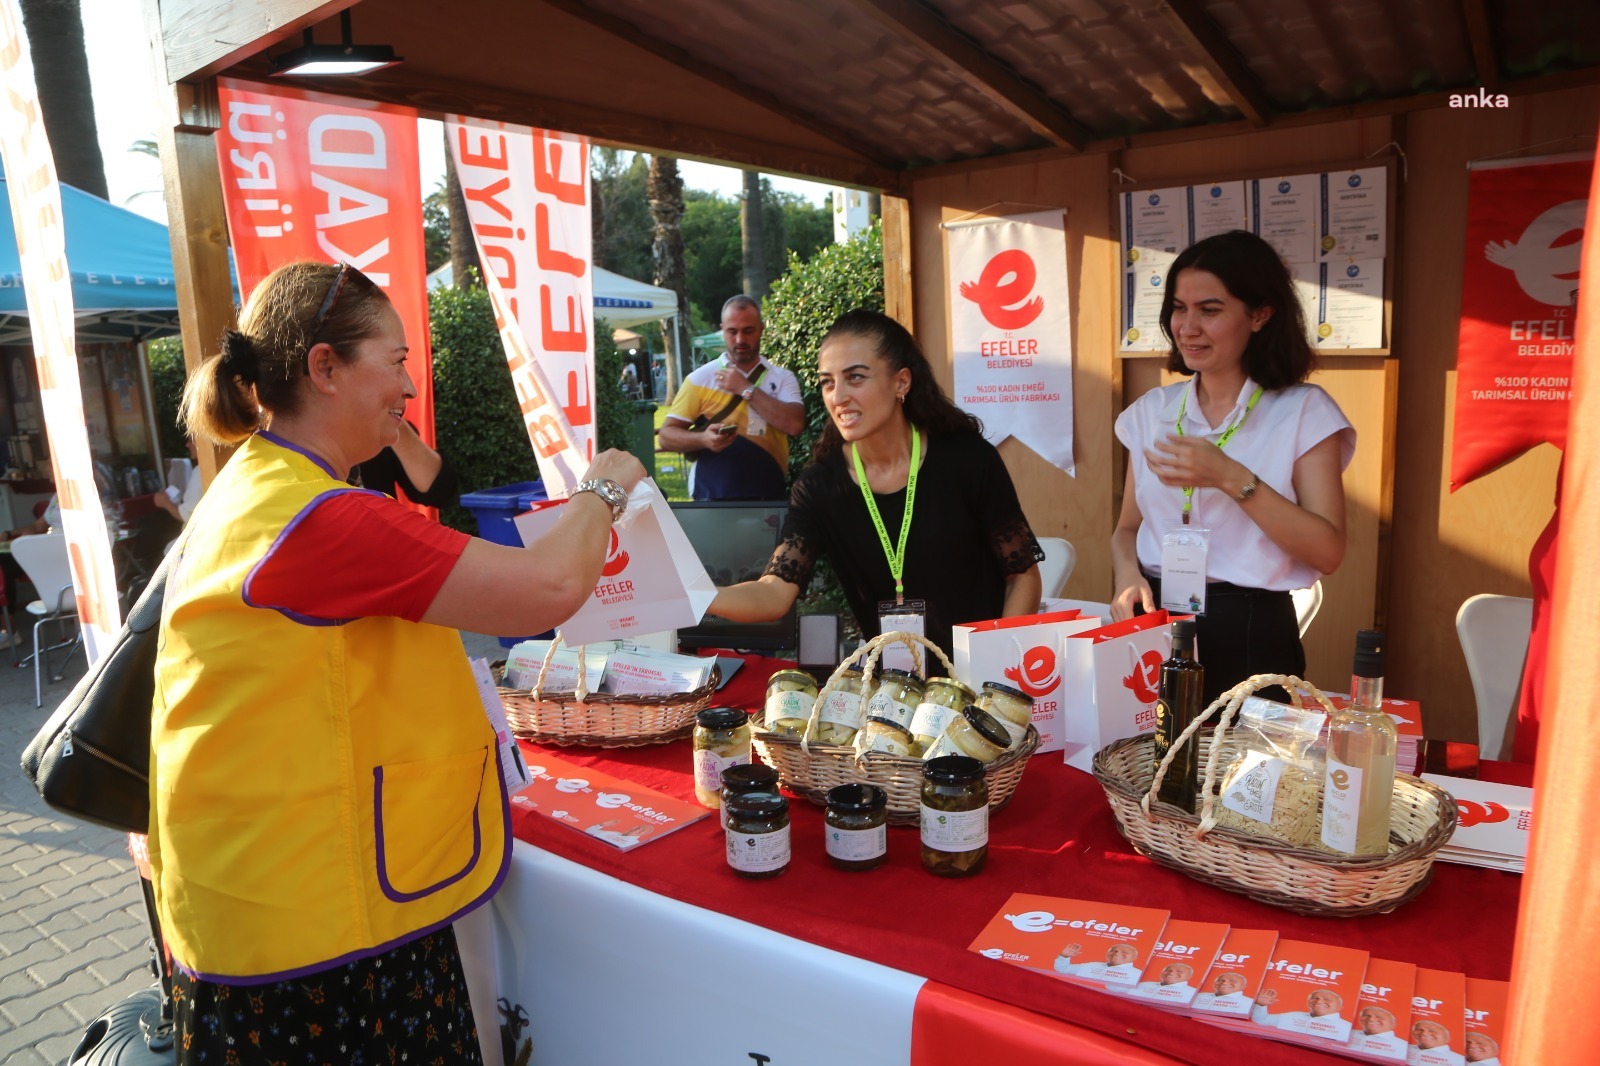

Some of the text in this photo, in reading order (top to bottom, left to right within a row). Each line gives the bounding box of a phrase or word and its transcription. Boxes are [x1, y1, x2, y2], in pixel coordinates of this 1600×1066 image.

[981, 339, 1038, 357] EFELER
[987, 357, 1033, 369] BELEDİYESİ
[976, 381, 1045, 394] %100 KADIN EMEĞİ
[1494, 376, 1568, 387] %100 KADIN
[963, 392, 1060, 405] TARIMSAL ÜRÜN FABRİKASI
[1471, 390, 1528, 400] TARIMSAL
[1530, 388, 1566, 400] ÜRÜN
[594, 579, 635, 598] EFELER
